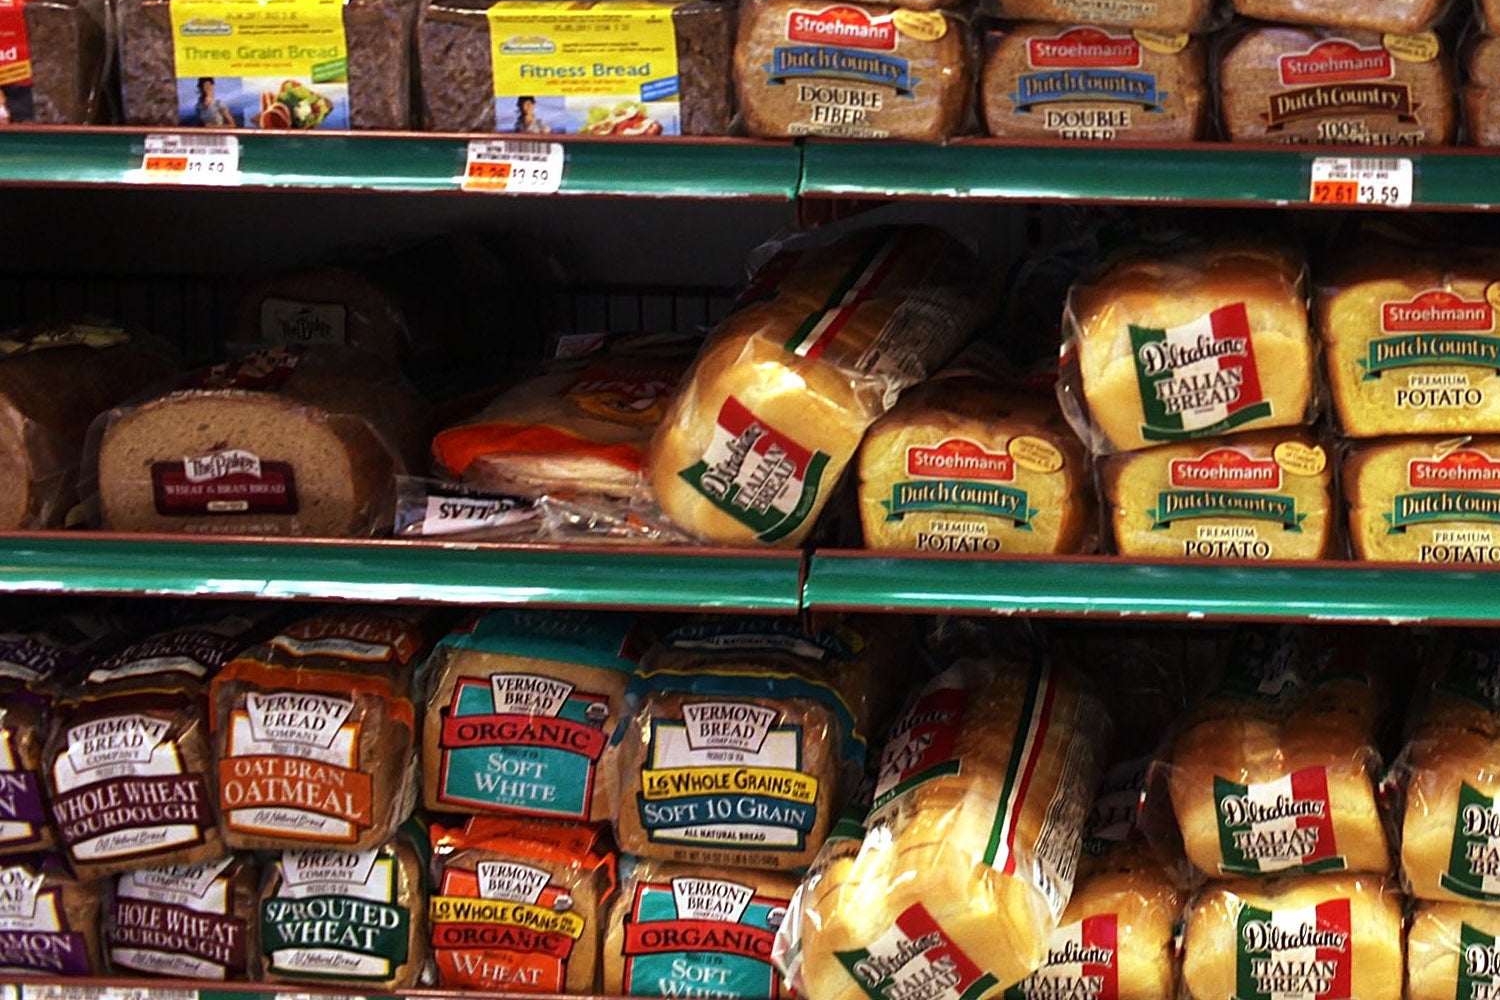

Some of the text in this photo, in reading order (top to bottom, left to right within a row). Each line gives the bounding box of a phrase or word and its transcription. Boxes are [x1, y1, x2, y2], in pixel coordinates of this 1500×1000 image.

[1360, 186, 1399, 203] $3.59
[1389, 306, 1486, 322] Stroehmann
[1156, 368, 1242, 399] ITALIAN
[1411, 376, 1466, 386] PREMIUM
[1165, 385, 1240, 414] BREAD
[1397, 388, 1483, 406] POTATO
[165, 484, 204, 496] WHEAT
[218, 484, 247, 495] BRAN
[250, 484, 286, 495] BREAD
[496, 677, 568, 702] VERMONT
[504, 692, 553, 710] BREAD
[252, 695, 351, 724] VERMONT
[263, 711, 325, 731] BREAD
[689, 706, 772, 728] VERMONT
[72, 721, 166, 743] VERMONT
[457, 722, 591, 750] ORGANIC
[700, 722, 755, 739] BREAD
[82, 733, 144, 755] BREAD
[234, 760, 345, 787] OAT BRAN
[487, 754, 547, 778] SOFT
[474, 773, 556, 801] WHITE
[670, 774, 730, 791] WHOLE
[733, 770, 791, 793] GRAINS
[54, 781, 200, 823] WHOLE WHEAT
[224, 781, 362, 818] OATMEAL
[644, 799, 806, 825] SOFT 10 GRAIN
[63, 805, 198, 840] SOURDOUGH
[265, 901, 399, 928] SPROUTED
[277, 922, 380, 950] WHEAT
[451, 952, 544, 985] WHEAT
